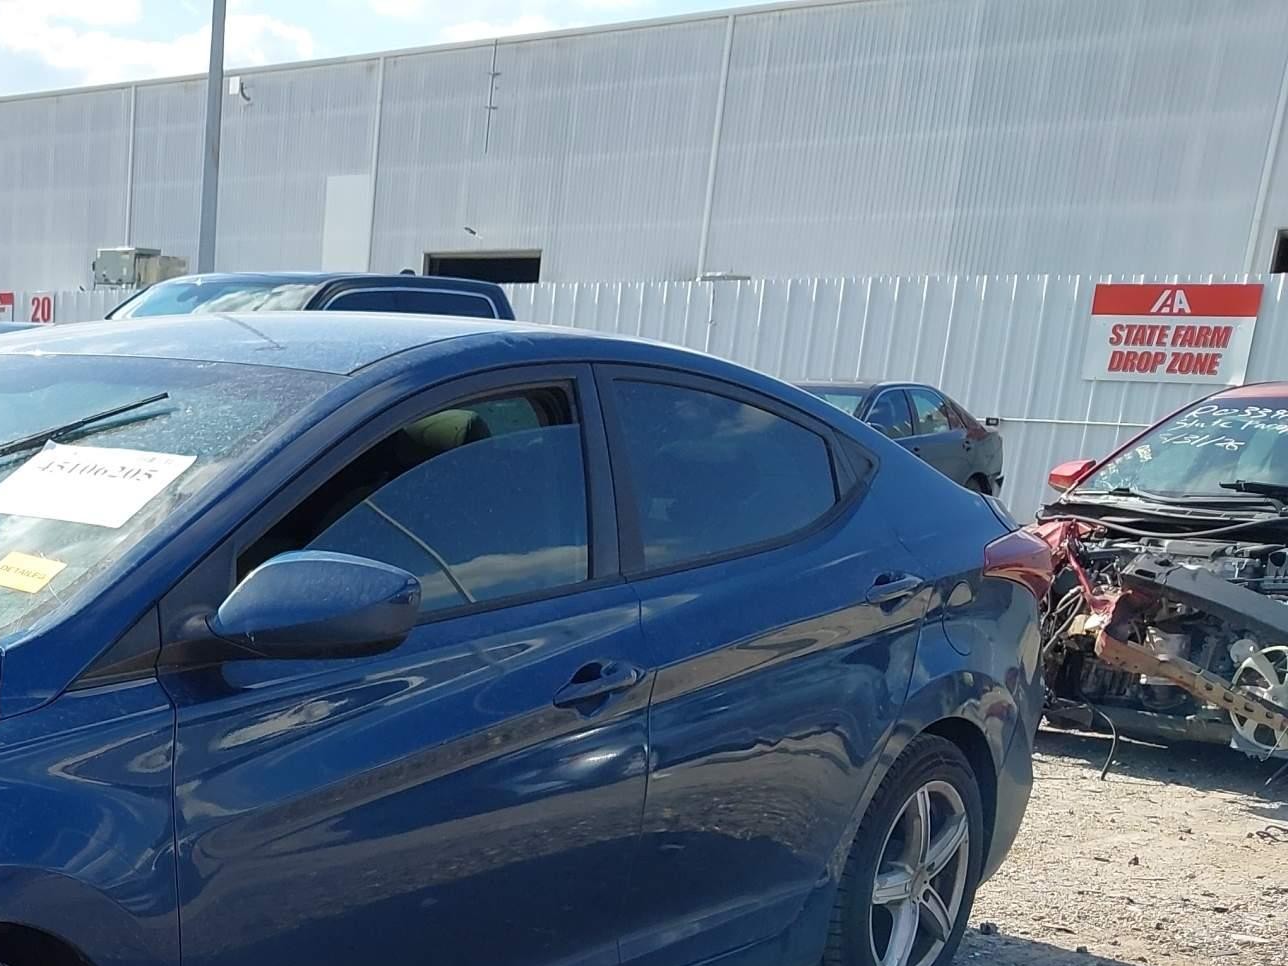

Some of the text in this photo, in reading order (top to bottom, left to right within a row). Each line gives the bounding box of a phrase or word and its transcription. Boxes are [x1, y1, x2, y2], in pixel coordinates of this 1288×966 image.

[32, 297, 51, 323] 20
[1109, 324, 1233, 348] STATE FARM
[1108, 350, 1222, 375] DROP ZONE
